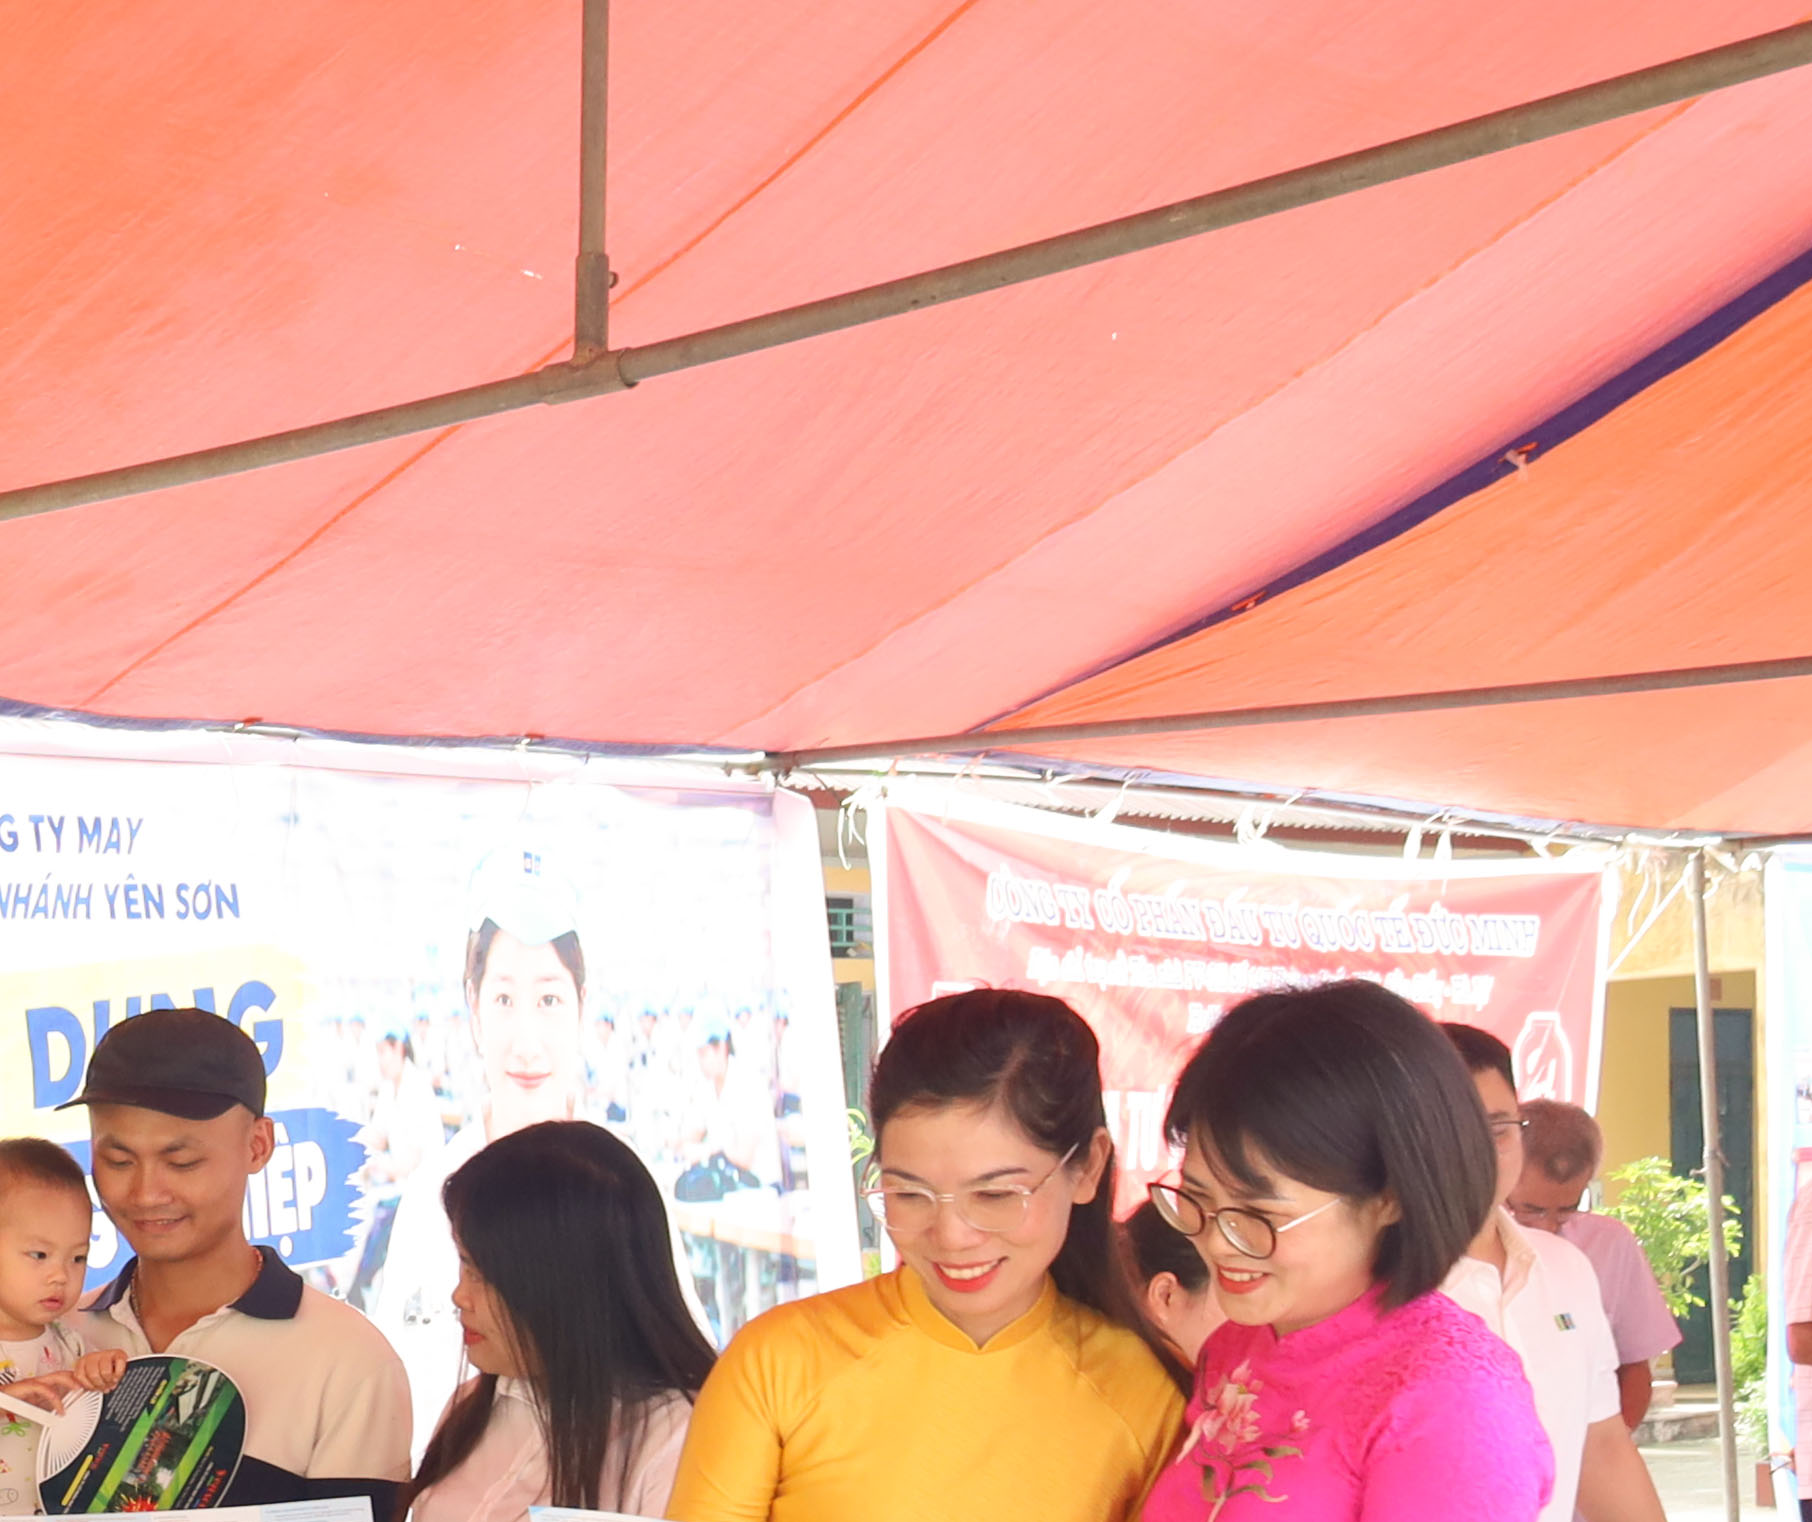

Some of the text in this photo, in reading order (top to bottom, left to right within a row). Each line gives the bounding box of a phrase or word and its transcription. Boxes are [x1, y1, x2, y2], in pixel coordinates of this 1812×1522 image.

[29, 814, 65, 854] TY
[78, 817, 144, 854] MAY
[103, 873, 166, 921] YÊN
[175, 879, 241, 921] SƠN
[1053, 883, 1095, 931] TY
[1465, 914, 1541, 958] MINH
[25, 979, 284, 1110] DG
